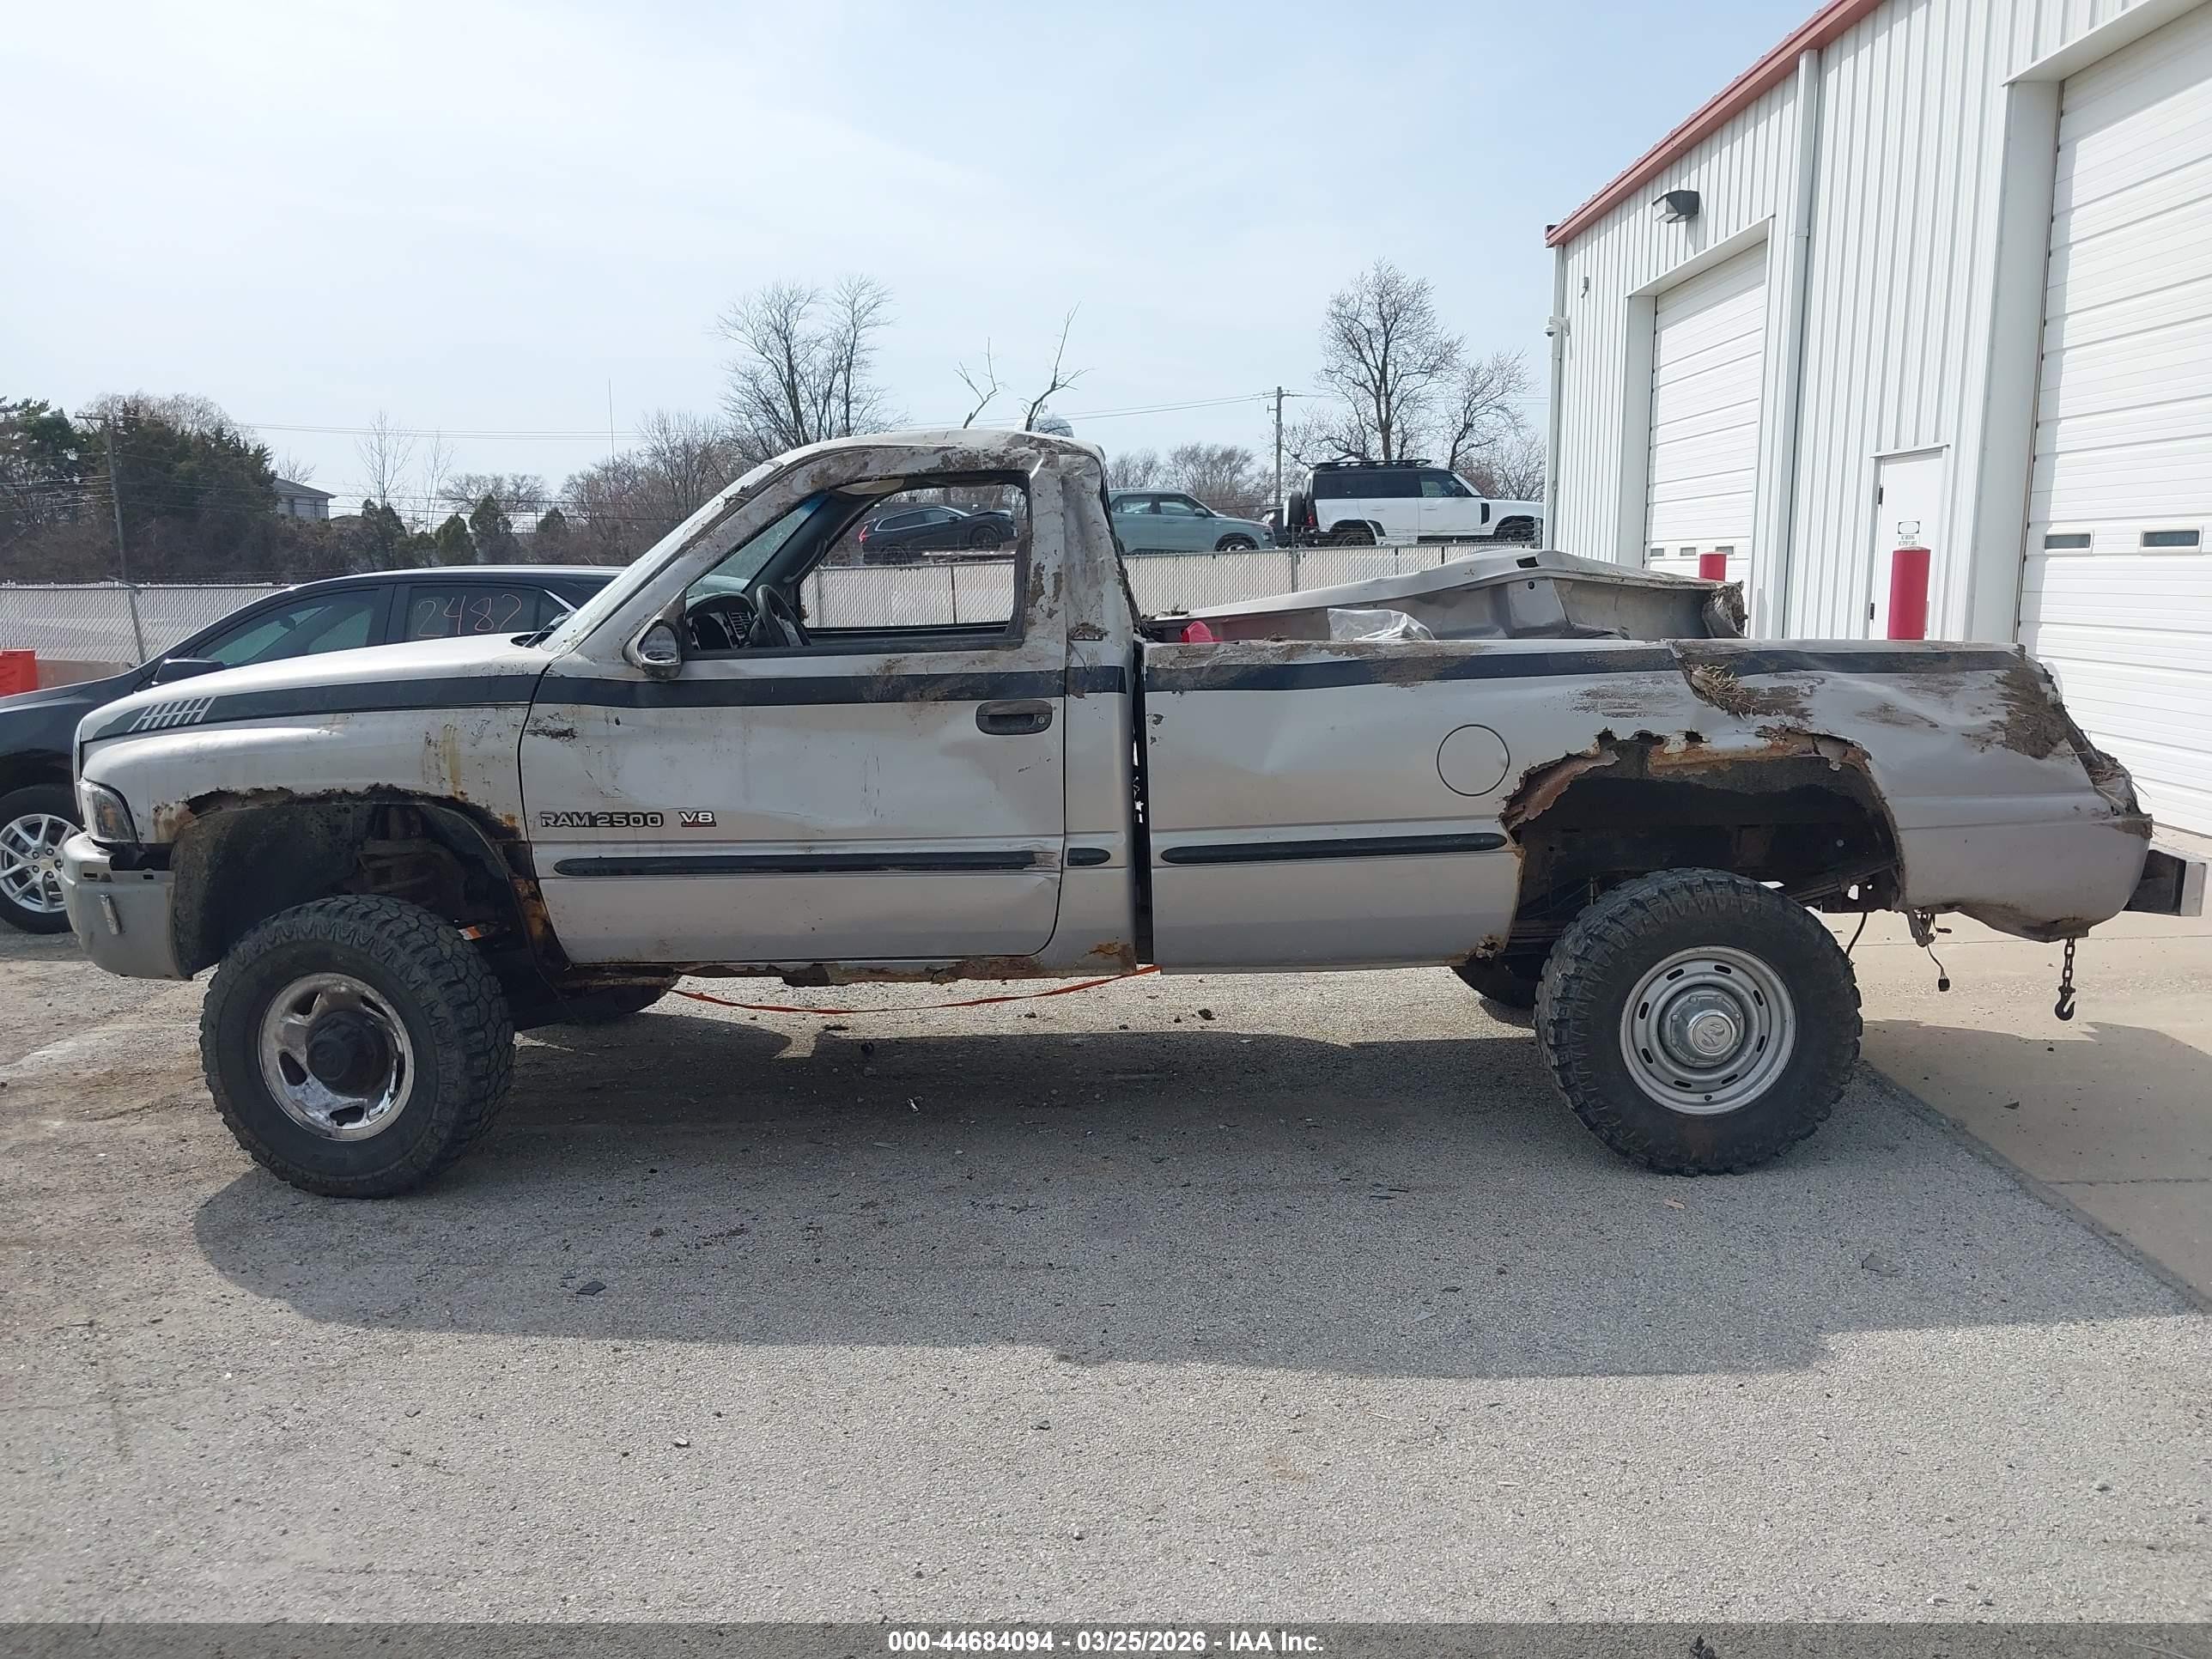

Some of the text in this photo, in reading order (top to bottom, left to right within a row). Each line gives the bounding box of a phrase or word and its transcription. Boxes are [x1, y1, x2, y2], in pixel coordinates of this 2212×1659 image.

[541, 811, 714, 827] RAM 2500 V8
